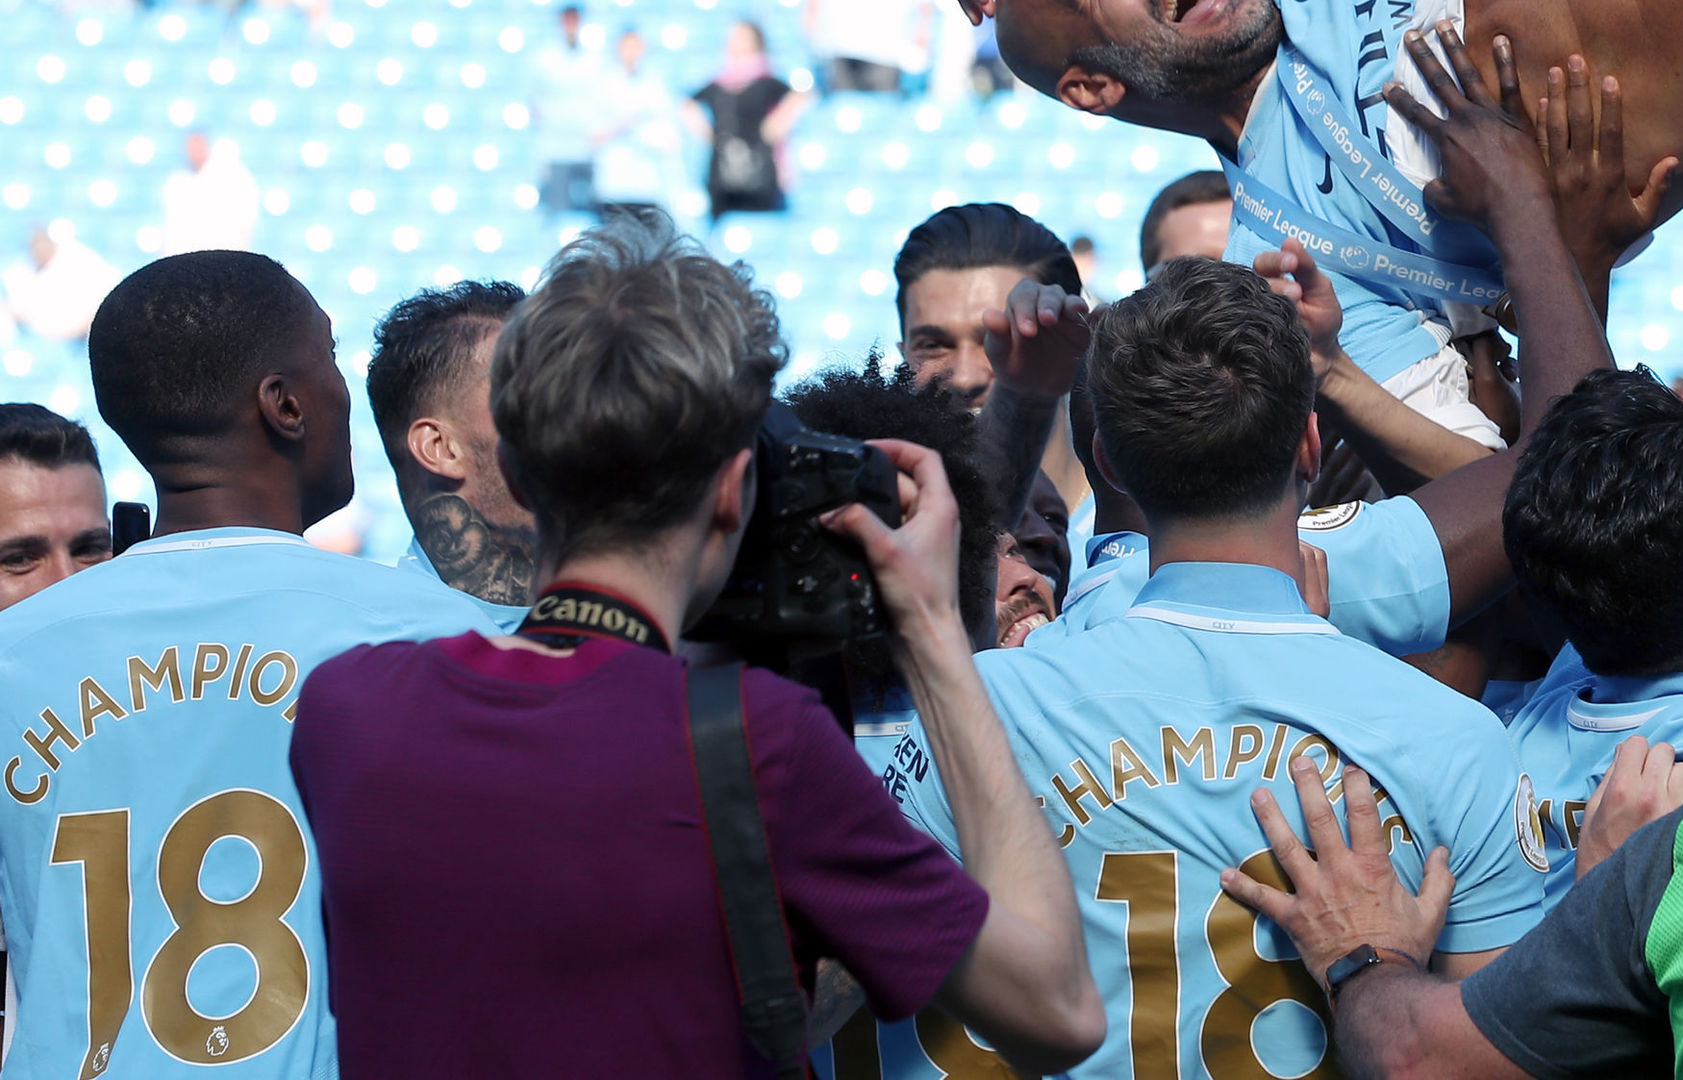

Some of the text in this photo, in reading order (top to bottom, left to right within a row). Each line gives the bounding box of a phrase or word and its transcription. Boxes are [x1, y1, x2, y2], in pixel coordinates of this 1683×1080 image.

[1321, 110, 1374, 179] League
[1233, 181, 1275, 223] Premier
[1272, 208, 1334, 256] League
[1372, 253, 1456, 293] Premier
[1371, 172, 1438, 237] Premier
[529, 595, 649, 643] Canon
[49, 788, 311, 1080] 18
